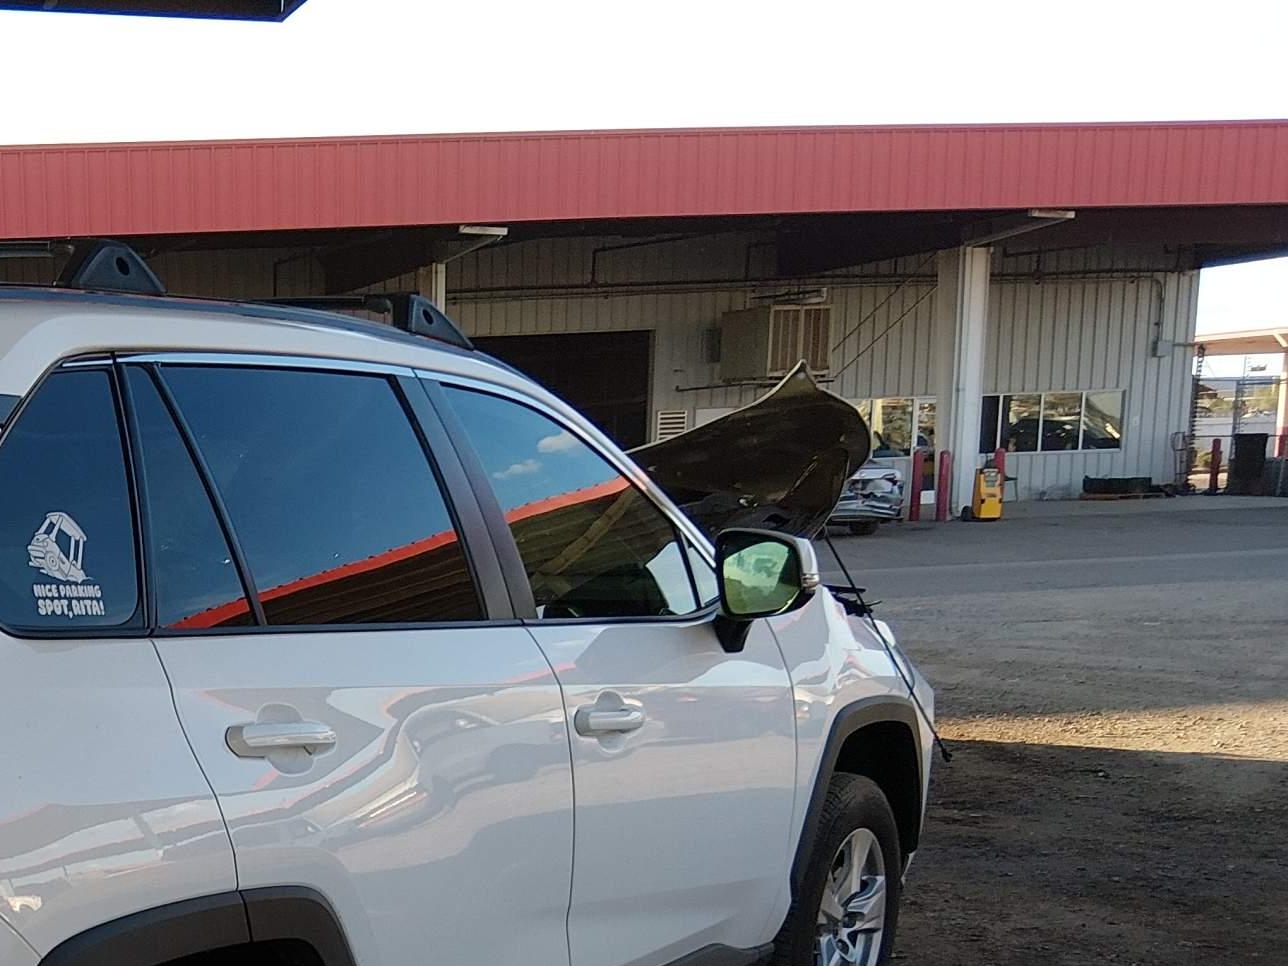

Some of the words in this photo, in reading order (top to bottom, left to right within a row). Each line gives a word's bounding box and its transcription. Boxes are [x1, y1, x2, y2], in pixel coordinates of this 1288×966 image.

[33, 584, 59, 598] NICE
[59, 585, 102, 598] PARKING
[38, 599, 73, 619] SPOT,
[72, 600, 105, 616] RITA!
